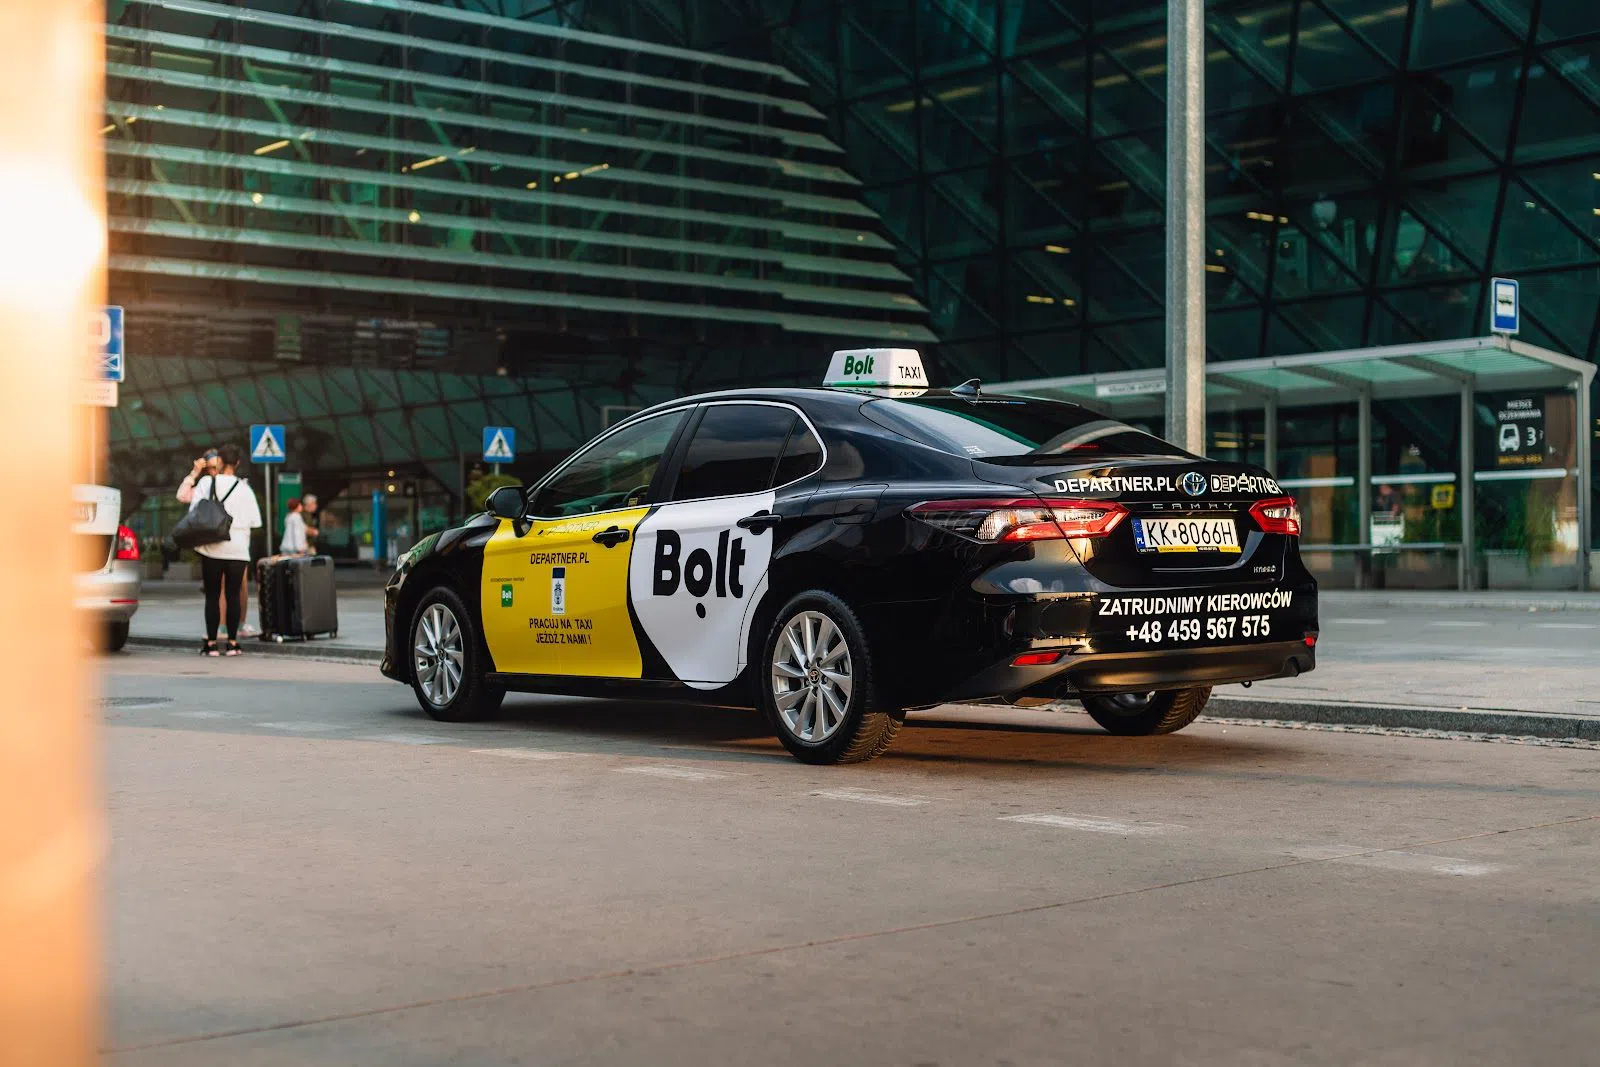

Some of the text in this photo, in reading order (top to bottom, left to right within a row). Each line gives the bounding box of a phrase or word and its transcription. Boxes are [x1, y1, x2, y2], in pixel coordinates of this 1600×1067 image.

[843, 355, 875, 380] Bolt
[898, 366, 921, 379] TAXI
[1527, 426, 1536, 446] 3
[1054, 476, 1175, 493] DEPARTNER.PL
[1210, 473, 1282, 494] DEPARTNER
[1136, 537, 1144, 545] PL
[1146, 521, 1234, 546] KK 8066H
[530, 552, 590, 564] DEPARTNER.PL
[653, 528, 746, 619] Bolt
[1099, 588, 1293, 616] ZATRUDNIMY KIEROWCÓW
[529, 618, 593, 630] PRACUJ NA TAXI
[1126, 615, 1270, 643] +48 459 567 575
[560, 633, 566, 644] Z
[567, 633, 587, 645] NAMI
